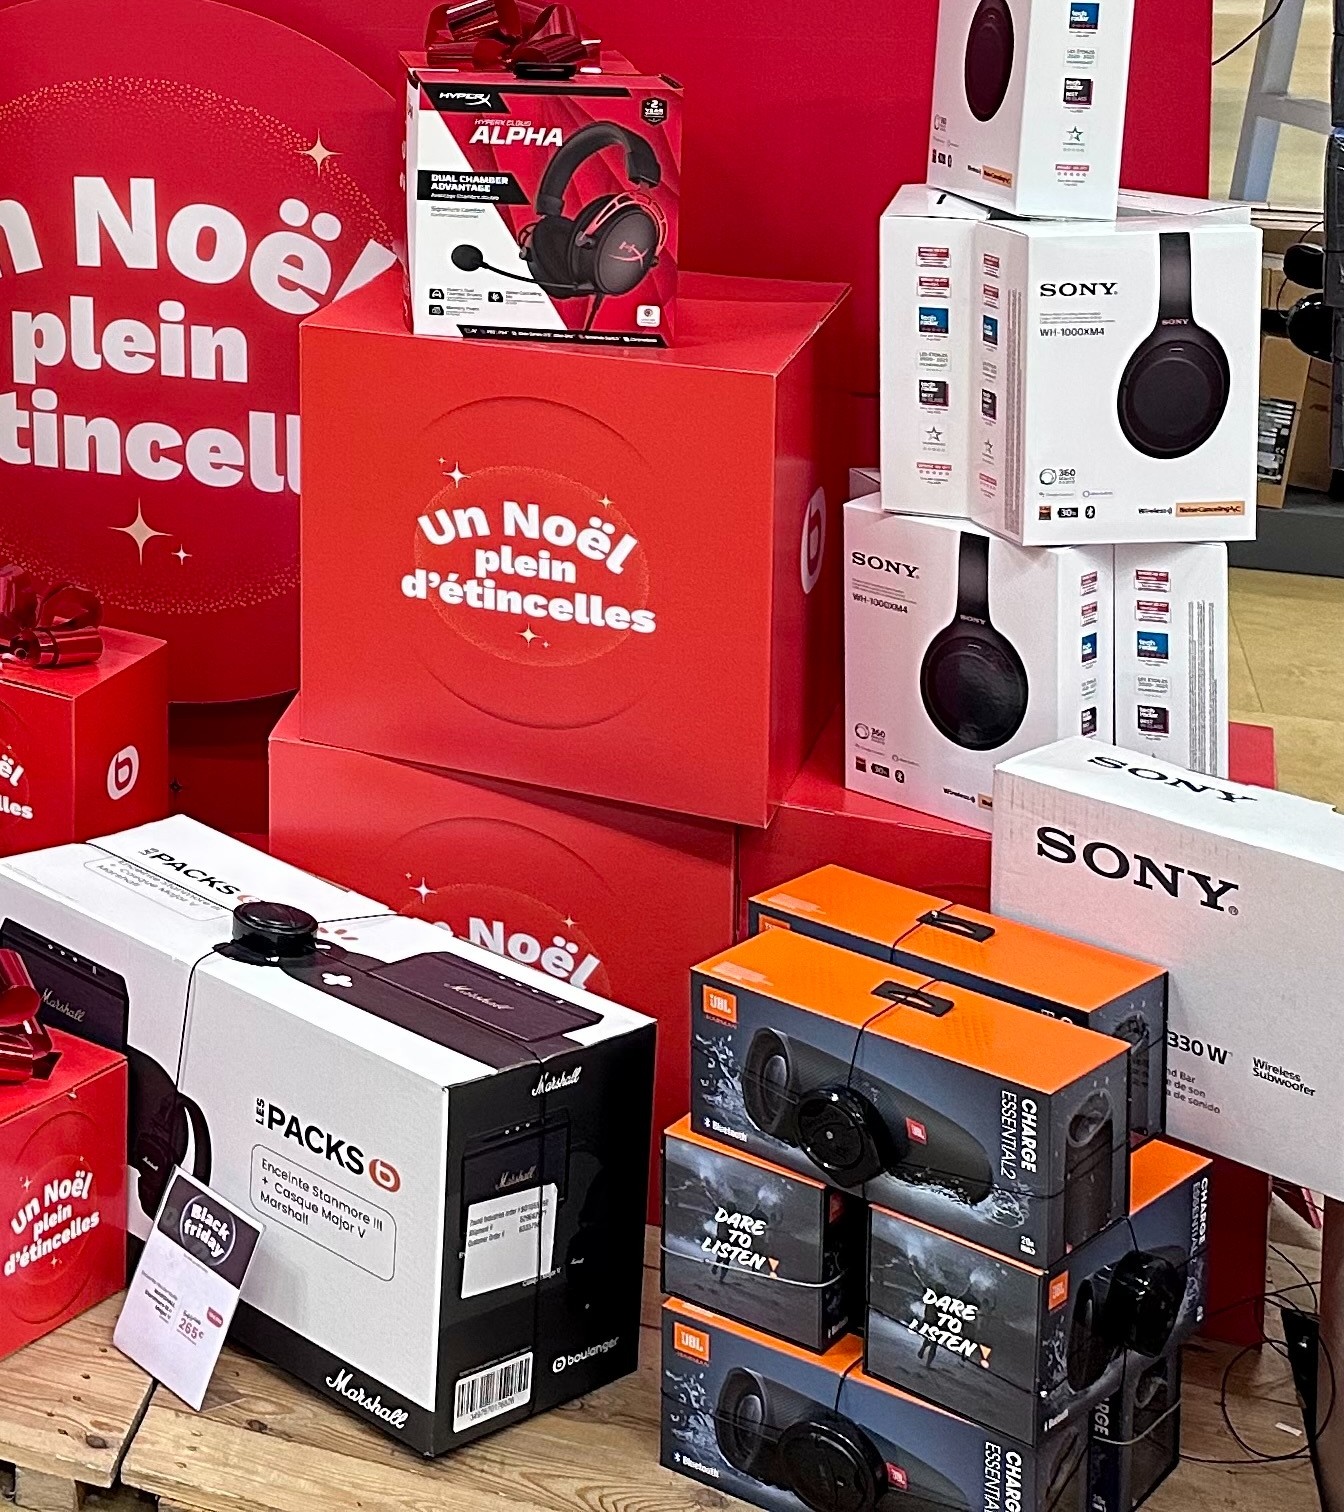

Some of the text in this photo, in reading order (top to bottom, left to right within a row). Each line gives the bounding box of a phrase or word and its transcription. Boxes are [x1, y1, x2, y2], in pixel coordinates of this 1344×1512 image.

[468, 126, 563, 147] ALPHA
[430, 183, 491, 192] ADVANTAGE
[431, 174, 509, 185] DUAL CHAMBER
[1039, 282, 1118, 297] SONY
[1161, 318, 1190, 326] SONY
[12, 295, 249, 385] plein
[417, 500, 638, 575] Un Noël
[475, 545, 576, 584] plein
[851, 552, 917, 579] SONY
[401, 569, 657, 634] d'étincelles
[960, 614, 986, 625] SONY
[1087, 756, 1258, 804] SONY
[150, 852, 241, 895] PACKS
[1036, 826, 1239, 913] SONY
[468, 916, 601, 990] Noël
[41, 987, 86, 1023] Marshall
[709, 994, 732, 1014] JBL
[532, 1066, 581, 1096] Marshall
[1179, 1069, 1196, 1084] Bar
[1252, 1068, 1315, 1097] Subwoofer
[1253, 1057, 1302, 1083] Wireless
[1188, 1086, 1207, 1098] son
[1188, 1096, 1221, 1115] sonido
[255, 1097, 366, 1175] LES PACKS
[1021, 1097, 1037, 1173] CHARGE
[261, 1156, 311, 1190] Enceinte
[312, 1185, 372, 1225] Stanmore
[494, 1165, 536, 1191] Marshall
[12, 1170, 93, 1236] Un Noël
[260, 1190, 310, 1226] Marshall
[274, 1182, 367, 1239] Casque Major V
[1198, 1177, 1209, 1246] CHARGE
[33, 1204, 73, 1238] plein
[190, 1203, 231, 1242] Black
[715, 1206, 767, 1236] DARE
[4, 1210, 100, 1276] d'étincelles
[183, 1218, 225, 1259] friday
[728, 1228, 752, 1249] TO
[922, 1287, 979, 1321] DARE
[938, 1312, 963, 1333] TO
[567, 1336, 620, 1366] boulanger
[680, 1331, 704, 1350] JBL
[325, 1367, 409, 1430] Marshall
